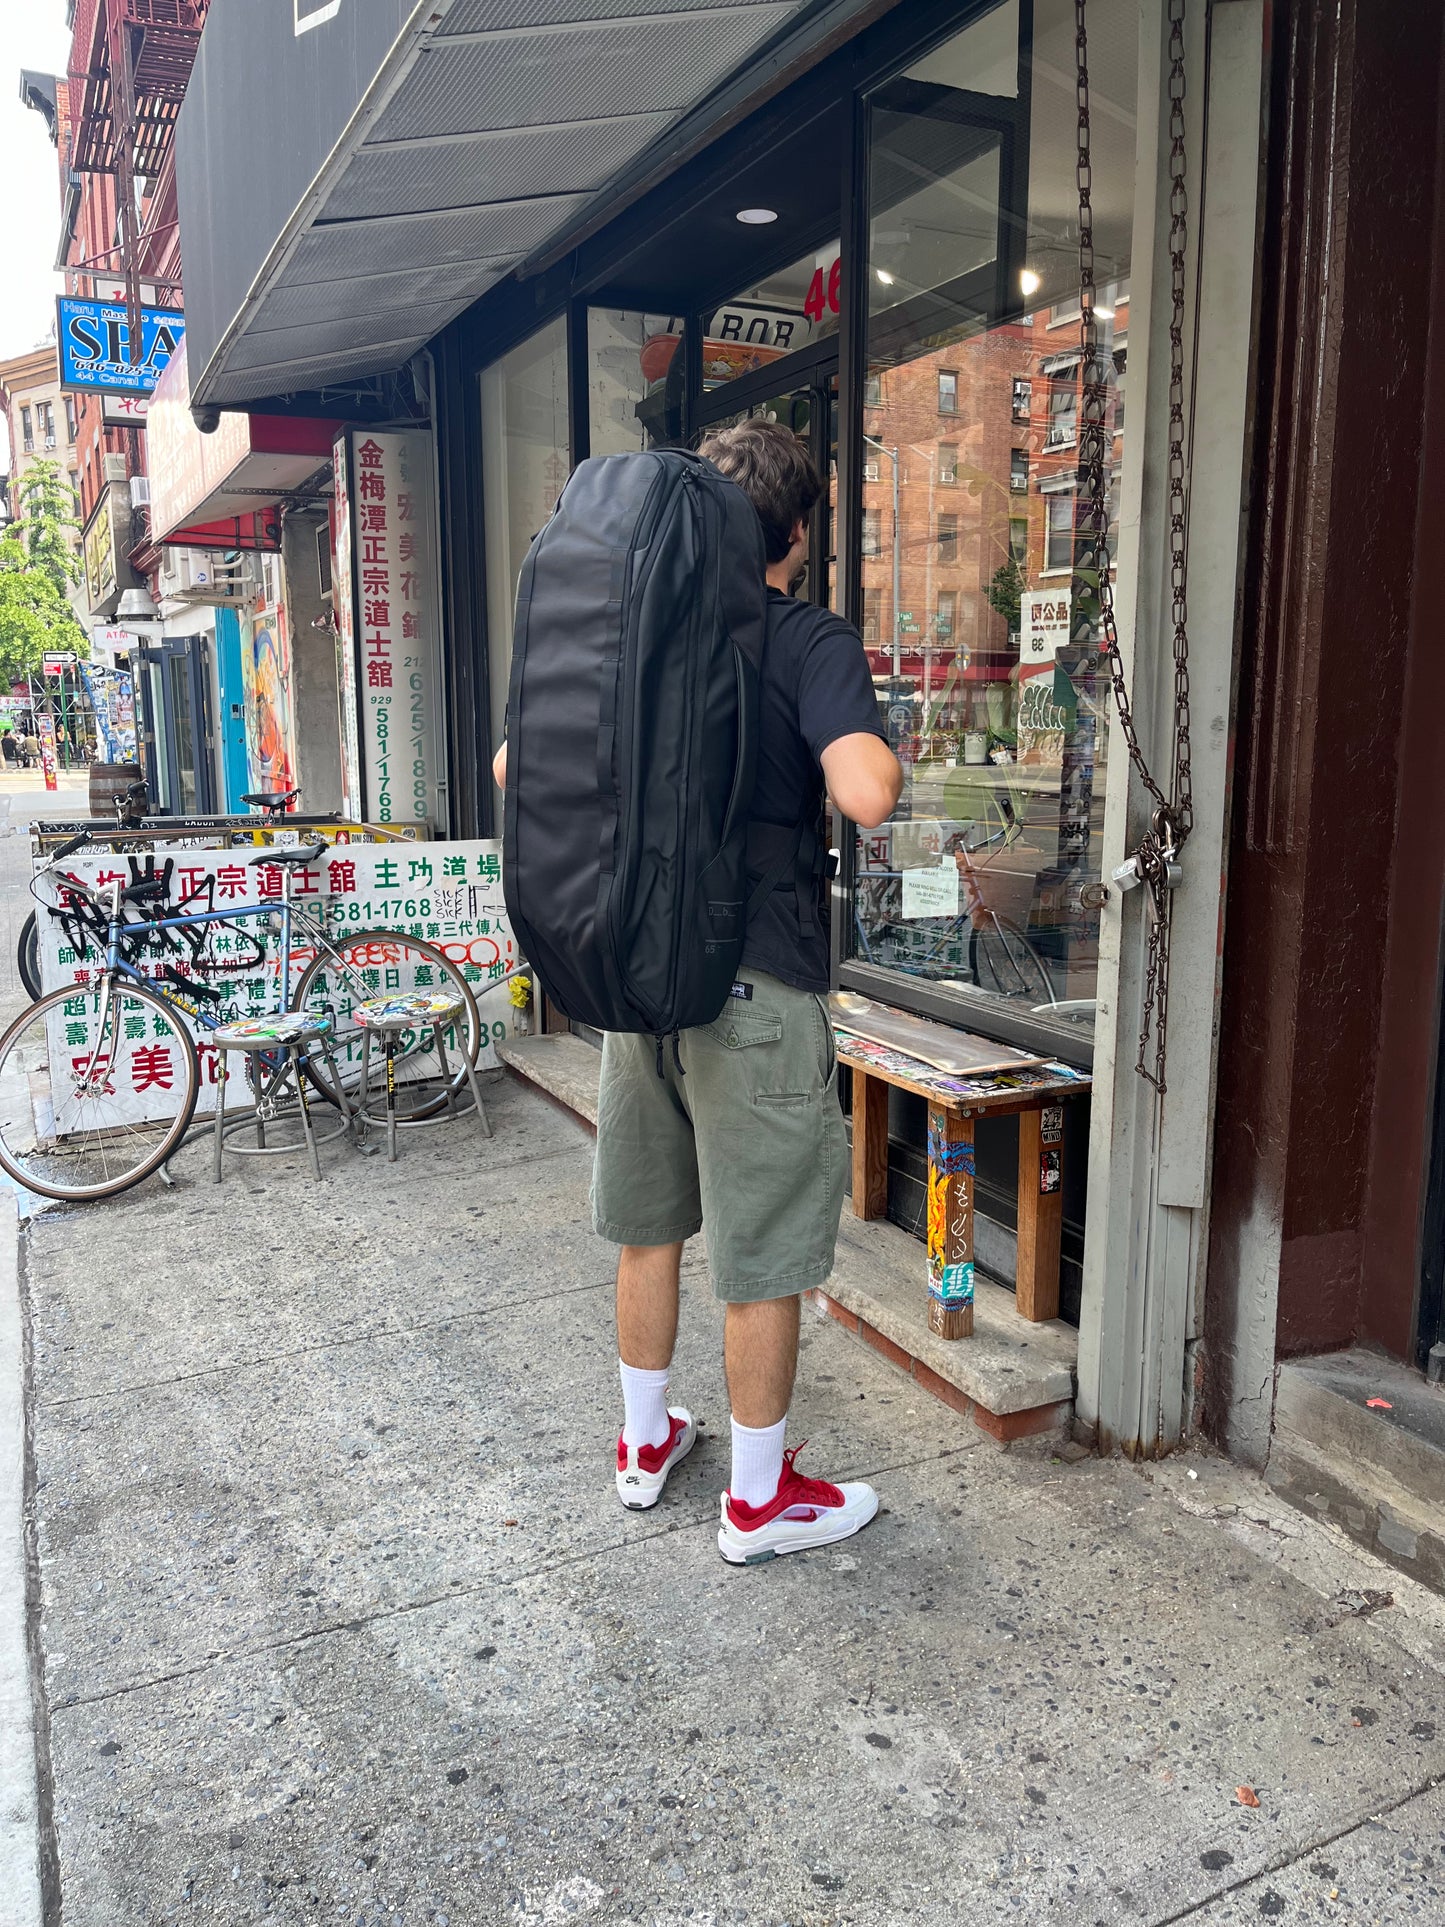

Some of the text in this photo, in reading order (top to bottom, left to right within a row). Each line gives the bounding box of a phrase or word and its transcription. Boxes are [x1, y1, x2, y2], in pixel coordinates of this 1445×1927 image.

[101, 309, 149, 322] Masse
[69, 315, 178, 368] SPA
[76, 372, 94, 381] 44
[99, 373, 138, 386] Canal
[106, 631, 128, 639] ATM
[370, 695, 393, 705] 929
[433, 888, 464, 899] SICK
[333, 898, 431, 922] 581-1768
[434, 899, 463, 909] SICK
[436, 907, 463, 920] SICK
[162, 986, 199, 1016] VINER
